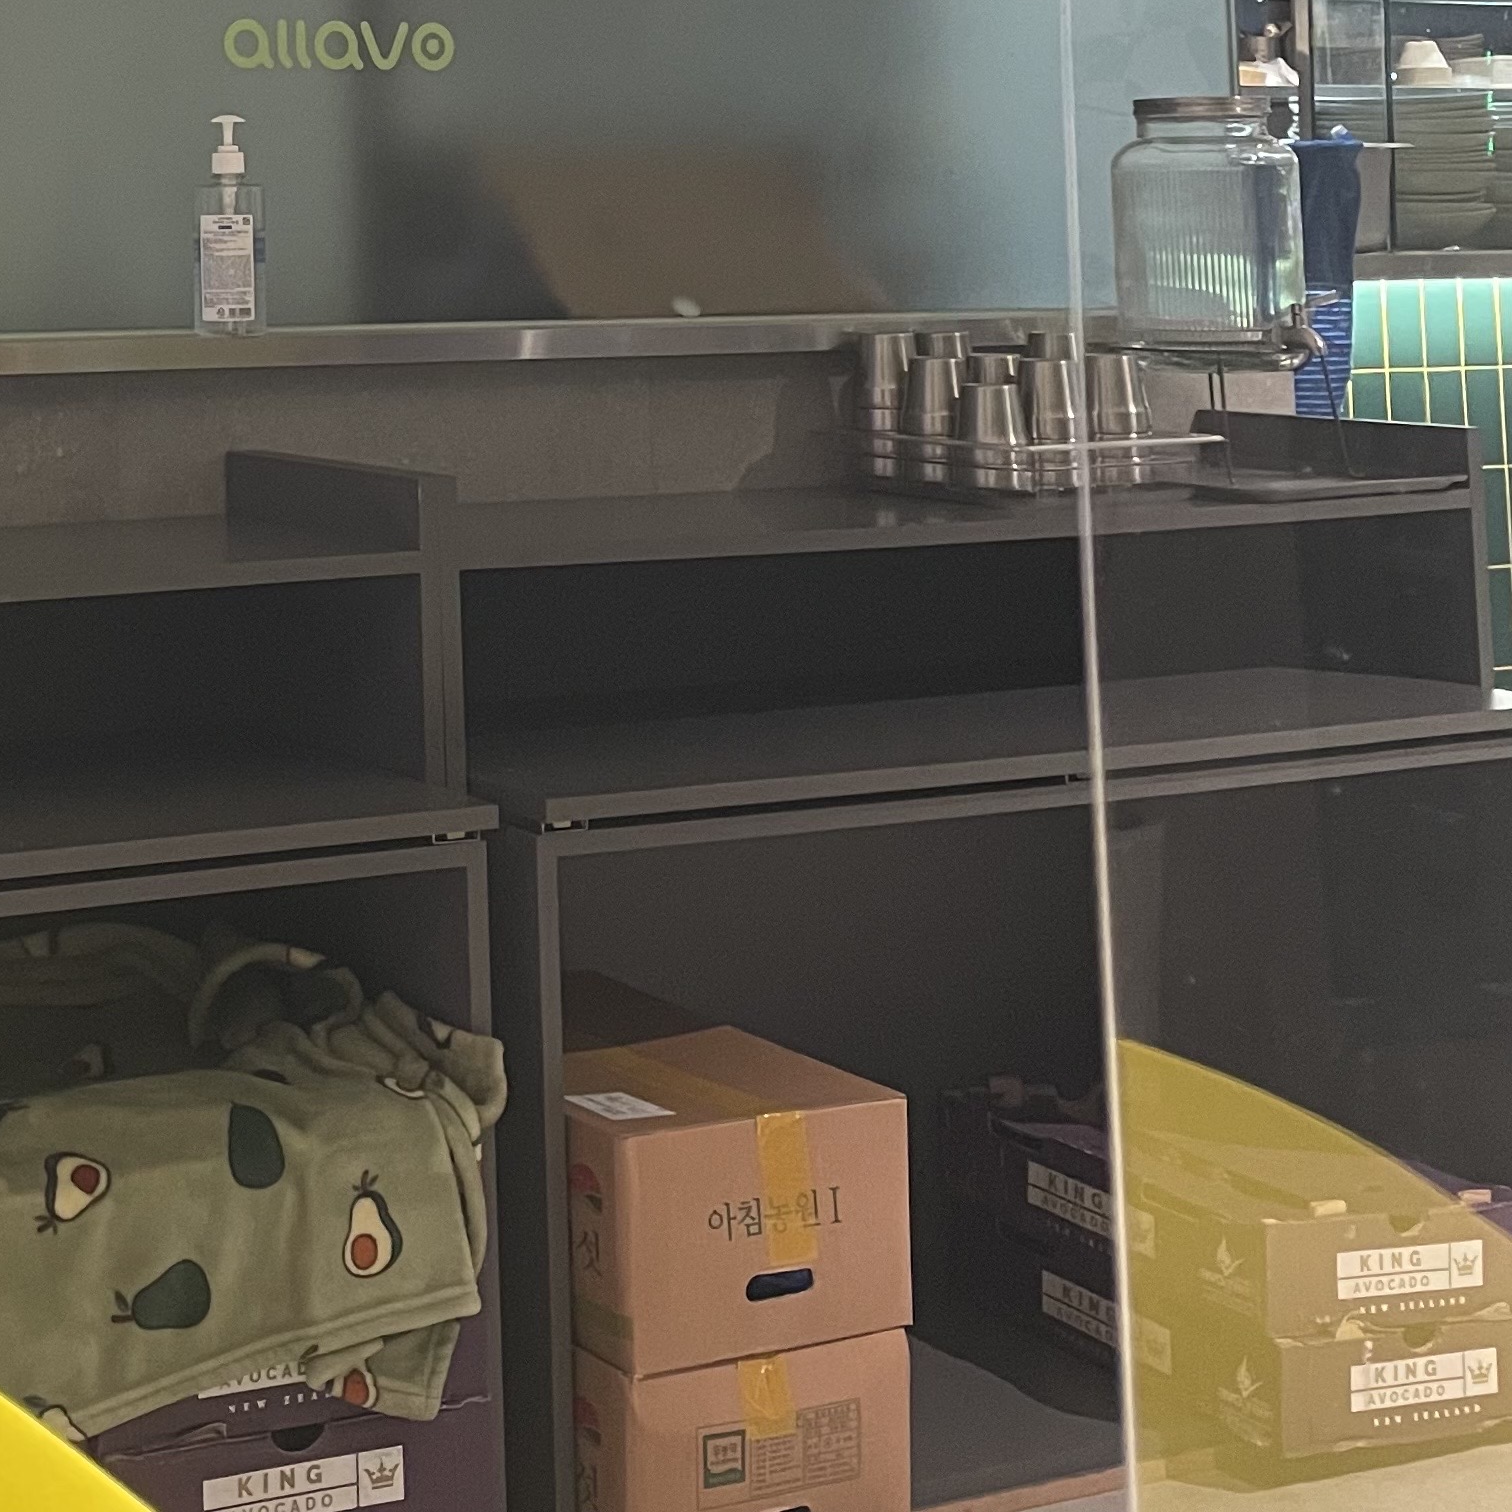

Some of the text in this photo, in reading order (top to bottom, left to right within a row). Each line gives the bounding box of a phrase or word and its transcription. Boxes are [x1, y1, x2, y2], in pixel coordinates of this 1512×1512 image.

[223, 16, 456, 73] allavo
[1048, 1170, 1104, 1210] KING
[1359, 1250, 1423, 1273] KING
[1352, 1275, 1431, 1296] AVOCADO
[1374, 1359, 1437, 1385] KING
[1366, 1384, 1446, 1407] AVOCADO
[237, 1463, 323, 1499] KING
[229, 1493, 334, 1512] OCADO
